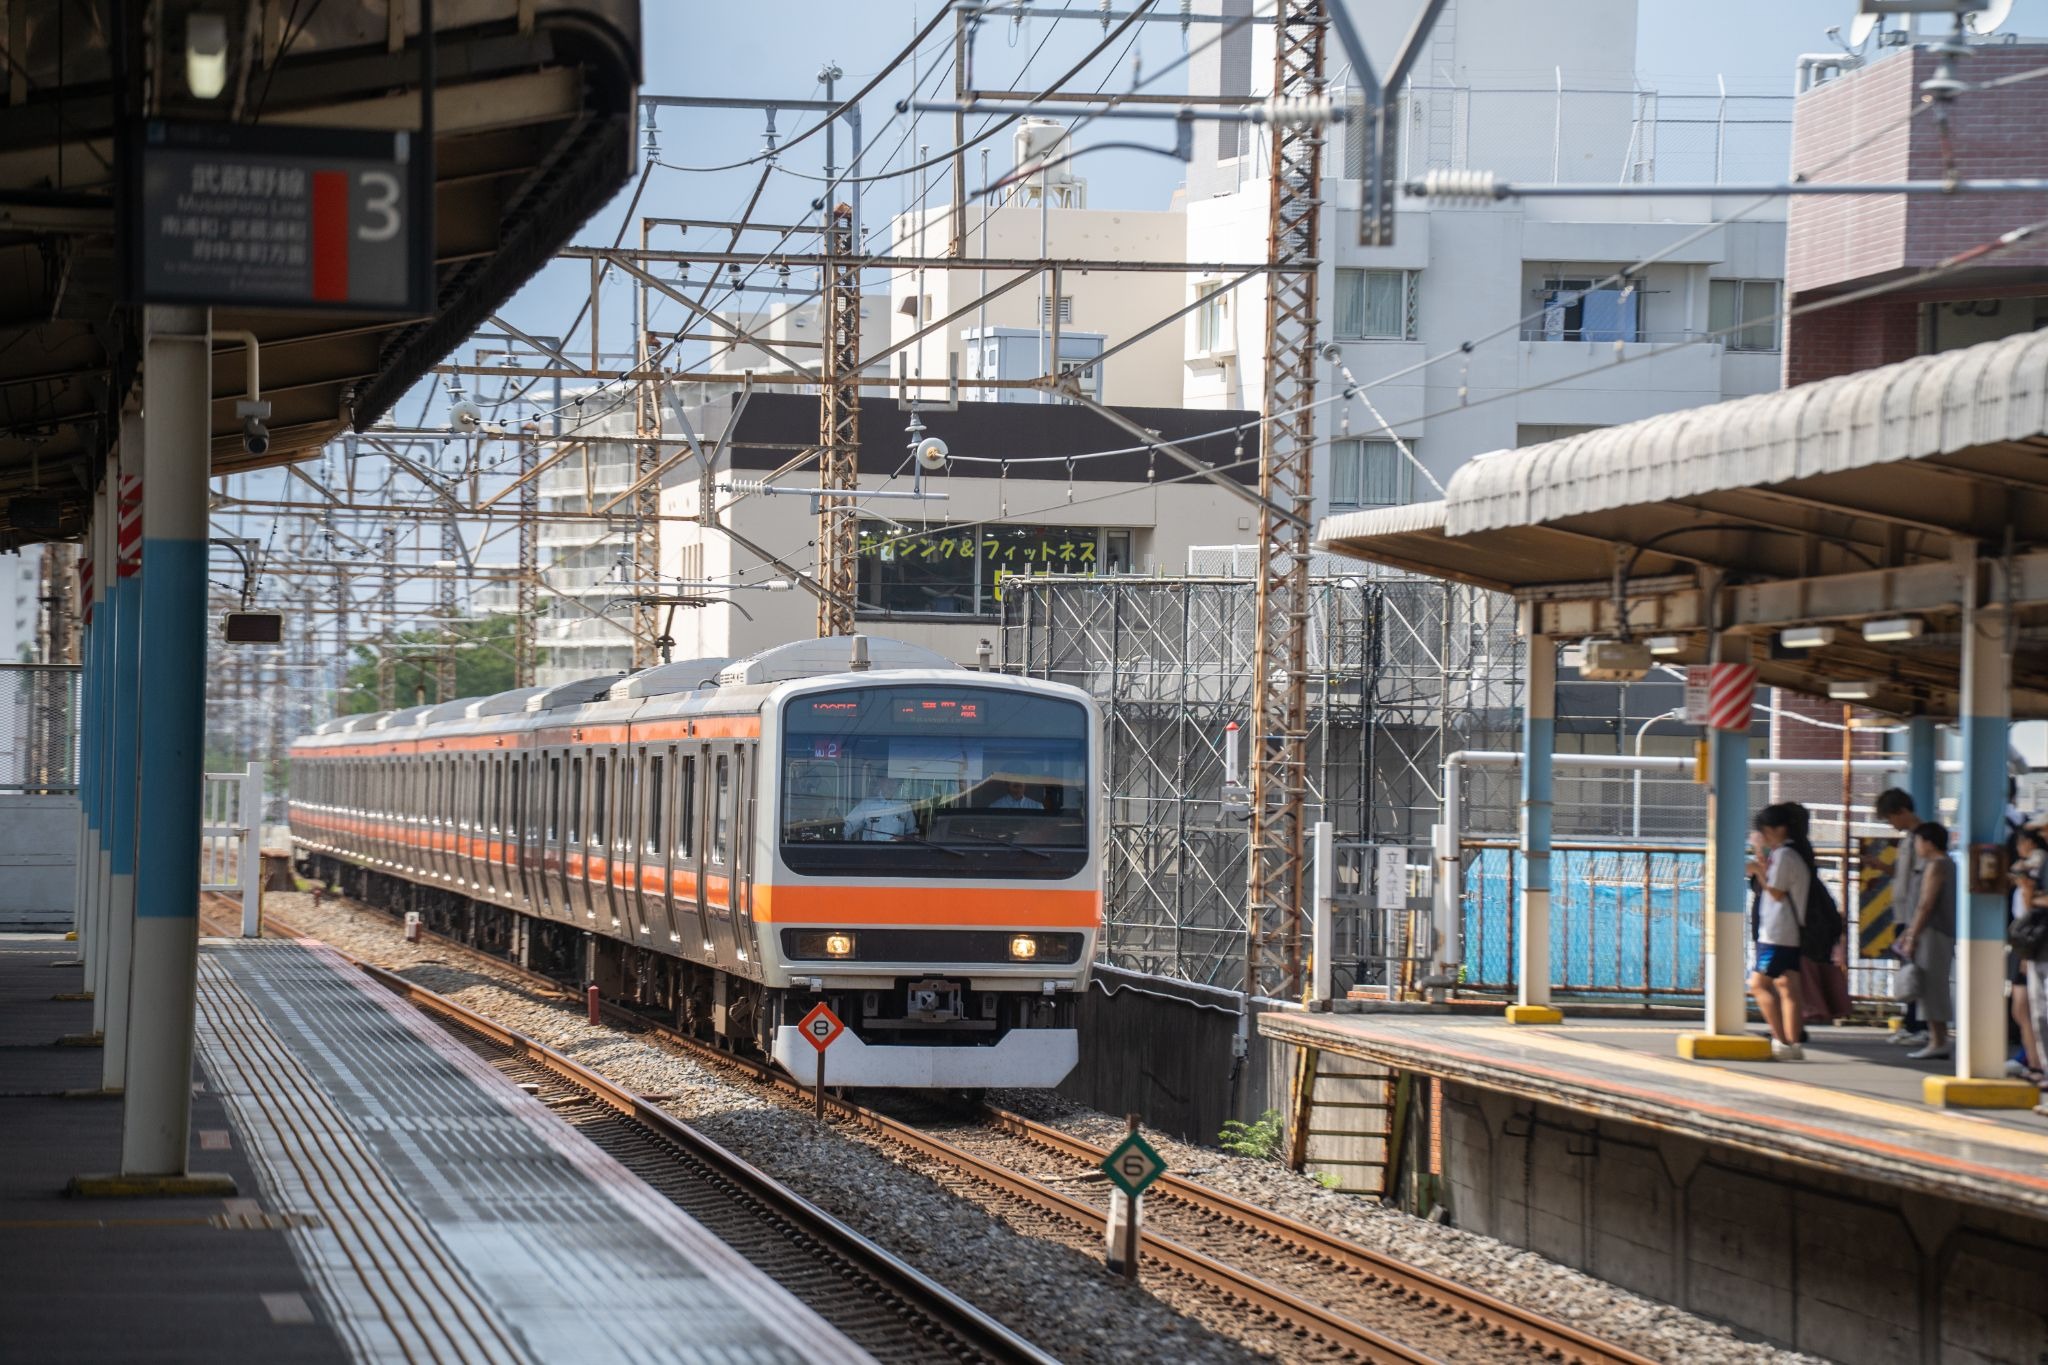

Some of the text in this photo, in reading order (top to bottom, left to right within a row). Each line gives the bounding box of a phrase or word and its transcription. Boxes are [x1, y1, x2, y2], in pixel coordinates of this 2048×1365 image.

[358, 171, 400, 242] 3
[828, 743, 837, 758] 2
[813, 1020, 829, 1036] 8
[1123, 1155, 1145, 1177] 6
